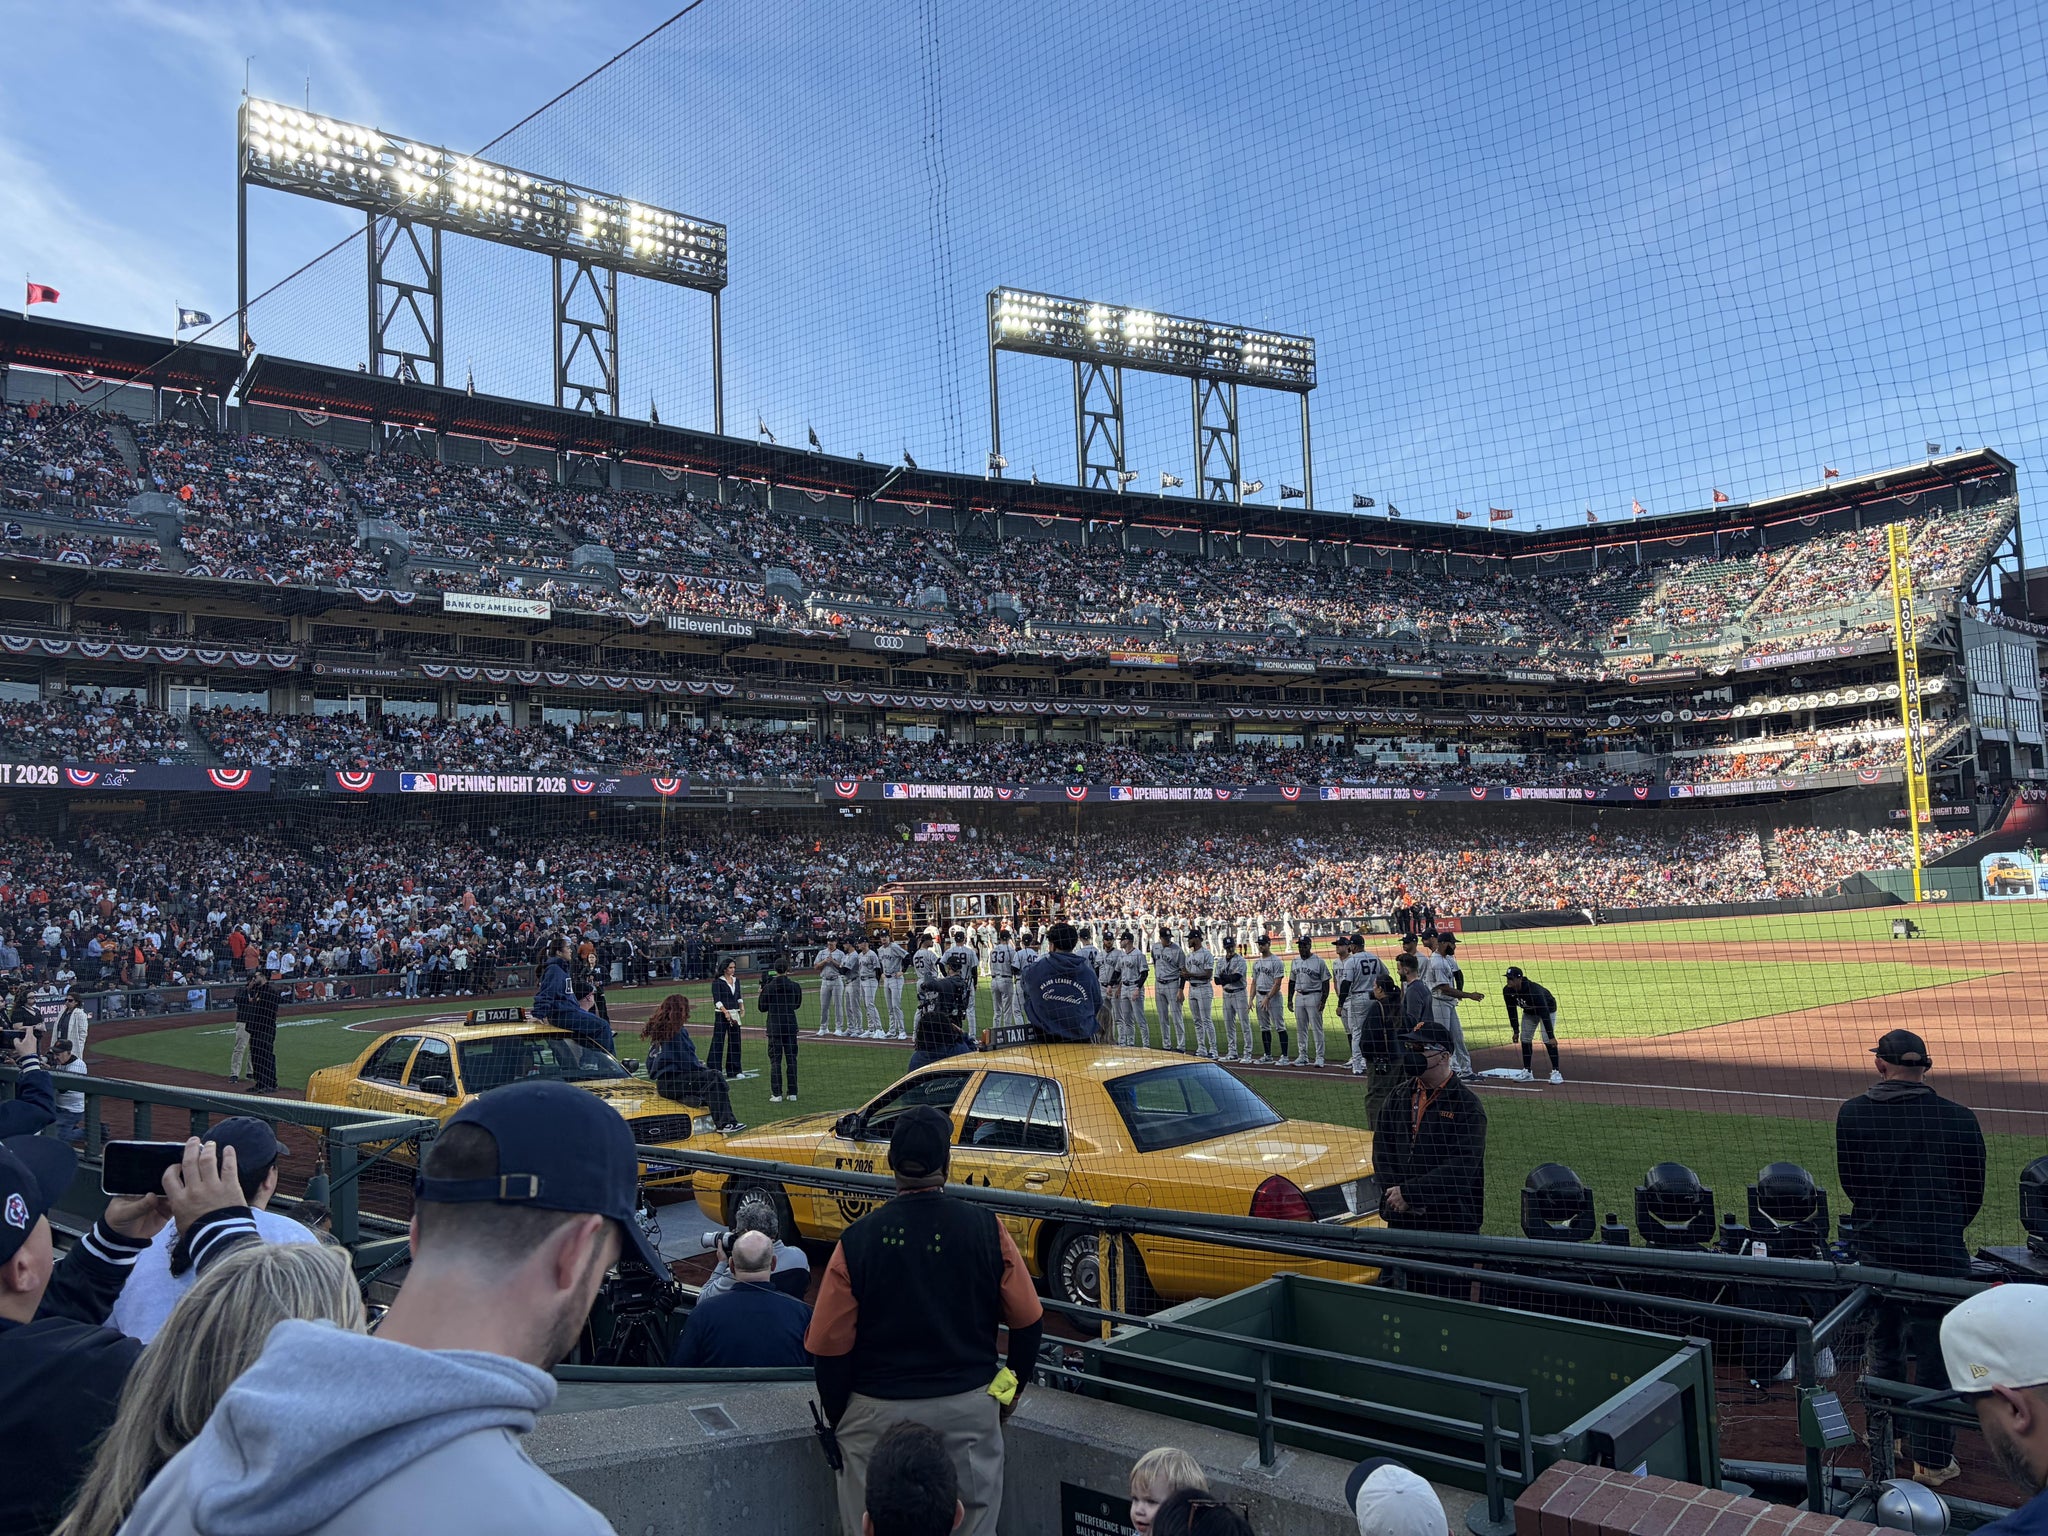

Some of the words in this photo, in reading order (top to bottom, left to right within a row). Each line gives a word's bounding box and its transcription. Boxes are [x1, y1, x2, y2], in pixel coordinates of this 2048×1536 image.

[446, 600, 471, 609] BANK
[474, 602, 486, 610] OF
[487, 604, 529, 614] AMERICA
[1902, 600, 1911, 640] ROOT
[1762, 652, 1794, 666] OPENING
[1794, 650, 1816, 661] NIGHT
[1816, 646, 1836, 657] 2026
[1904, 650, 1914, 660] 4
[1289, 662, 1314, 670] MINOLTA
[1514, 672, 1526, 680] MLB
[1528, 673, 1555, 681] NETWORK
[1888, 688, 1897, 696] 30
[1906, 669, 1917, 702] THA
[1930, 682, 1940, 690] 44
[300, 694, 310, 702] 221
[1910, 710, 1922, 773] CHIKIN
[16, 765, 58, 785] 2026
[438, 775, 496, 792] OPENING
[497, 776, 533, 793] NIGHT
[536, 777, 566, 793] 2026
[1694, 783, 1730, 796] OPENING
[1730, 782, 1754, 793] NIGHT
[1756, 780, 1777, 791] 2026
[908, 784, 947, 799] OPENING
[948, 784, 972, 800] NIGHT
[973, 785, 994, 800] 2026
[1133, 788, 1168, 800] OPENING
[1169, 788, 1192, 800] NIGHT
[1193, 788, 1213, 800] 2026
[1340, 788, 1371, 800] OPENING
[1372, 788, 1392, 800] NIGHT
[1394, 788, 1410, 800] 2026
[1522, 788, 1548, 800] OPENING
[1549, 788, 1566, 800] NIGHT
[1568, 788, 1582, 800] 2026
[1954, 806, 1970, 814] 2026
[936, 824, 960, 832] OPENING
[914, 833, 930, 842] NIGHT
[931, 833, 944, 842] 2026
[1922, 890, 1948, 900] 339
[915, 956, 924, 970] 25
[992, 951, 1005, 964] 33
[1360, 958, 1378, 976] 67
[1042, 988, 1084, 1004] Essentials
[40, 1004, 57, 1015] PLACE
[488, 1010, 508, 1020] TAXI
[1006, 1028, 1026, 1042] TAXI
[854, 1160, 873, 1174] 2026
[1074, 1512, 1119, 1534] INTERFERENCE
